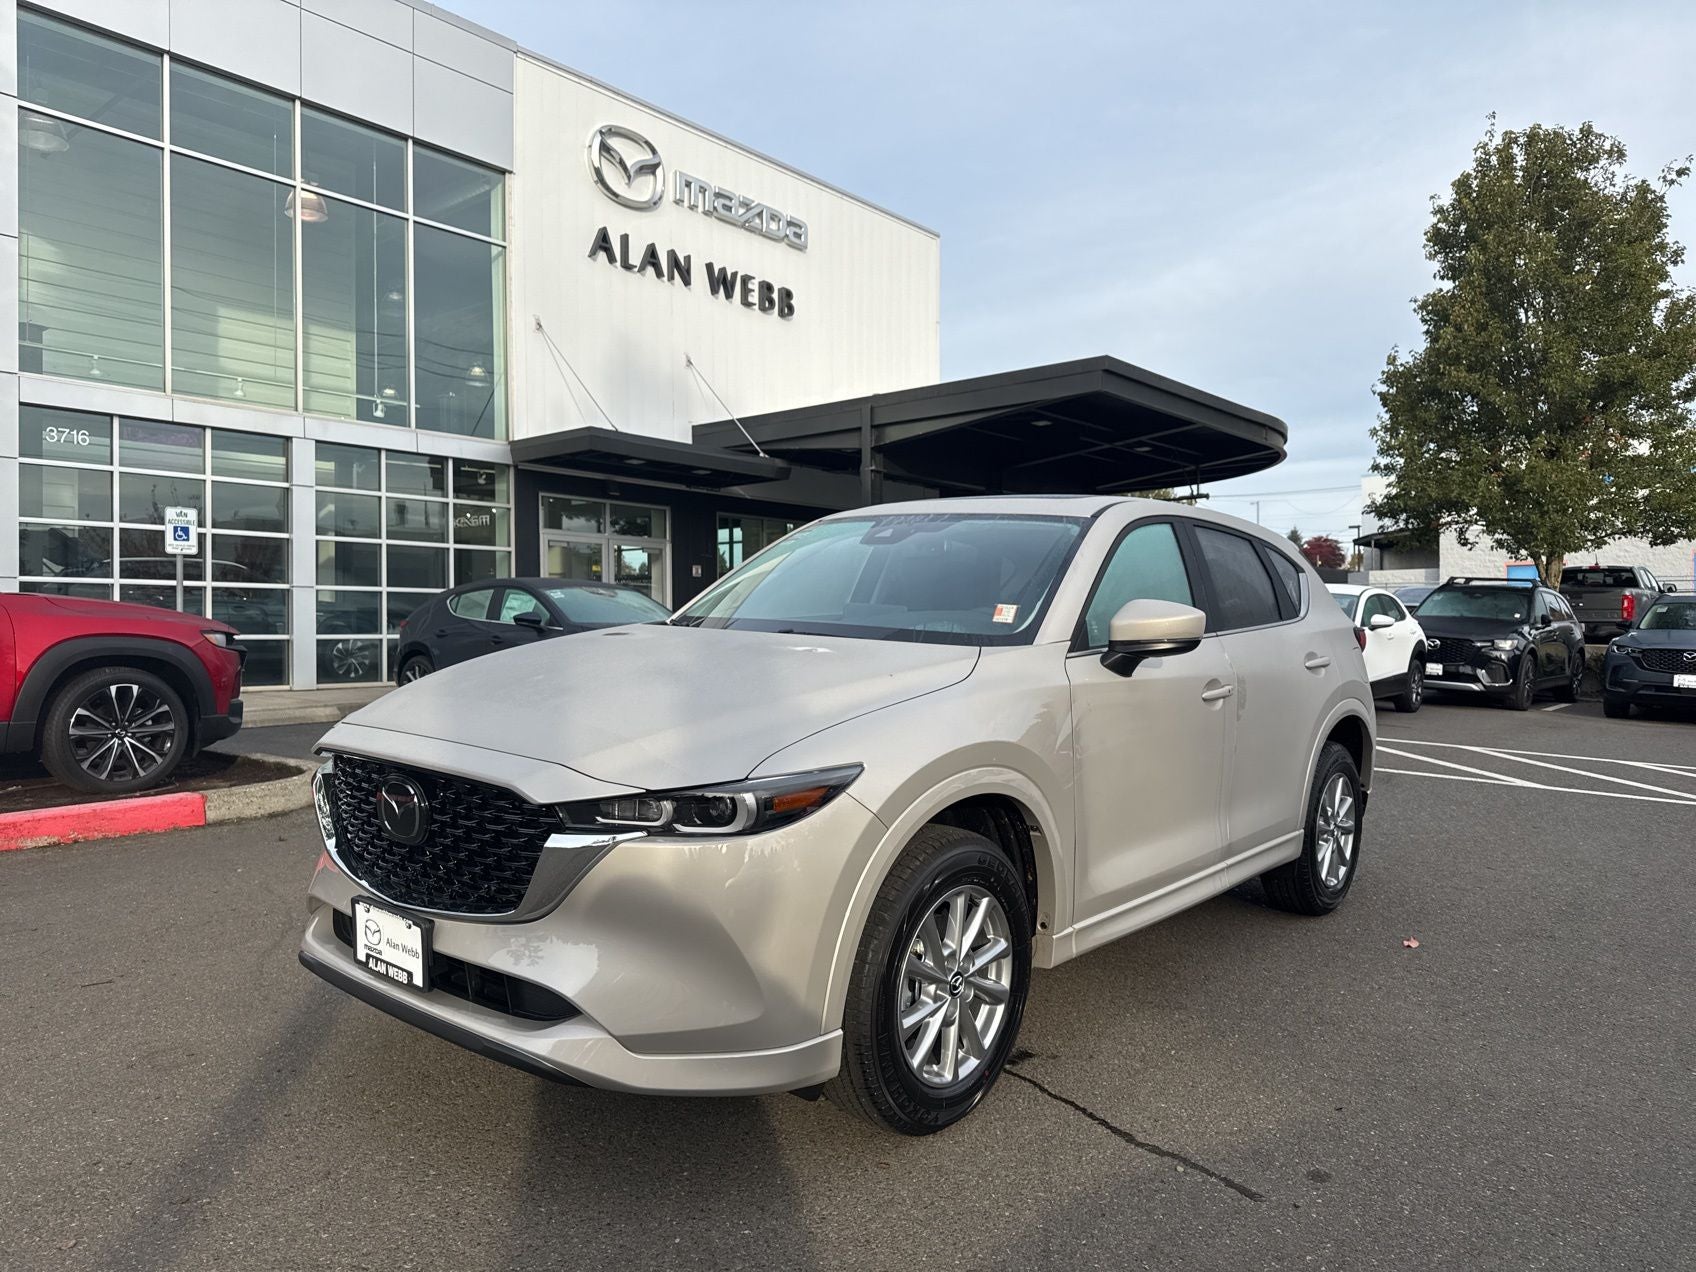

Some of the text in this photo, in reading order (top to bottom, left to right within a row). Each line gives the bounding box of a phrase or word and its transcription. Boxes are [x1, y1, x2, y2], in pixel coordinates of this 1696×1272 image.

[588, 226, 795, 319] ALAN WEBB
[45, 426, 90, 446] 3716
[167, 518, 196, 526] ACCESSIBLE
[175, 510, 188, 518] VAN
[364, 944, 383, 956] mazda
[386, 938, 420, 959] Alan Webb
[368, 957, 408, 984] ALAN WEBB
